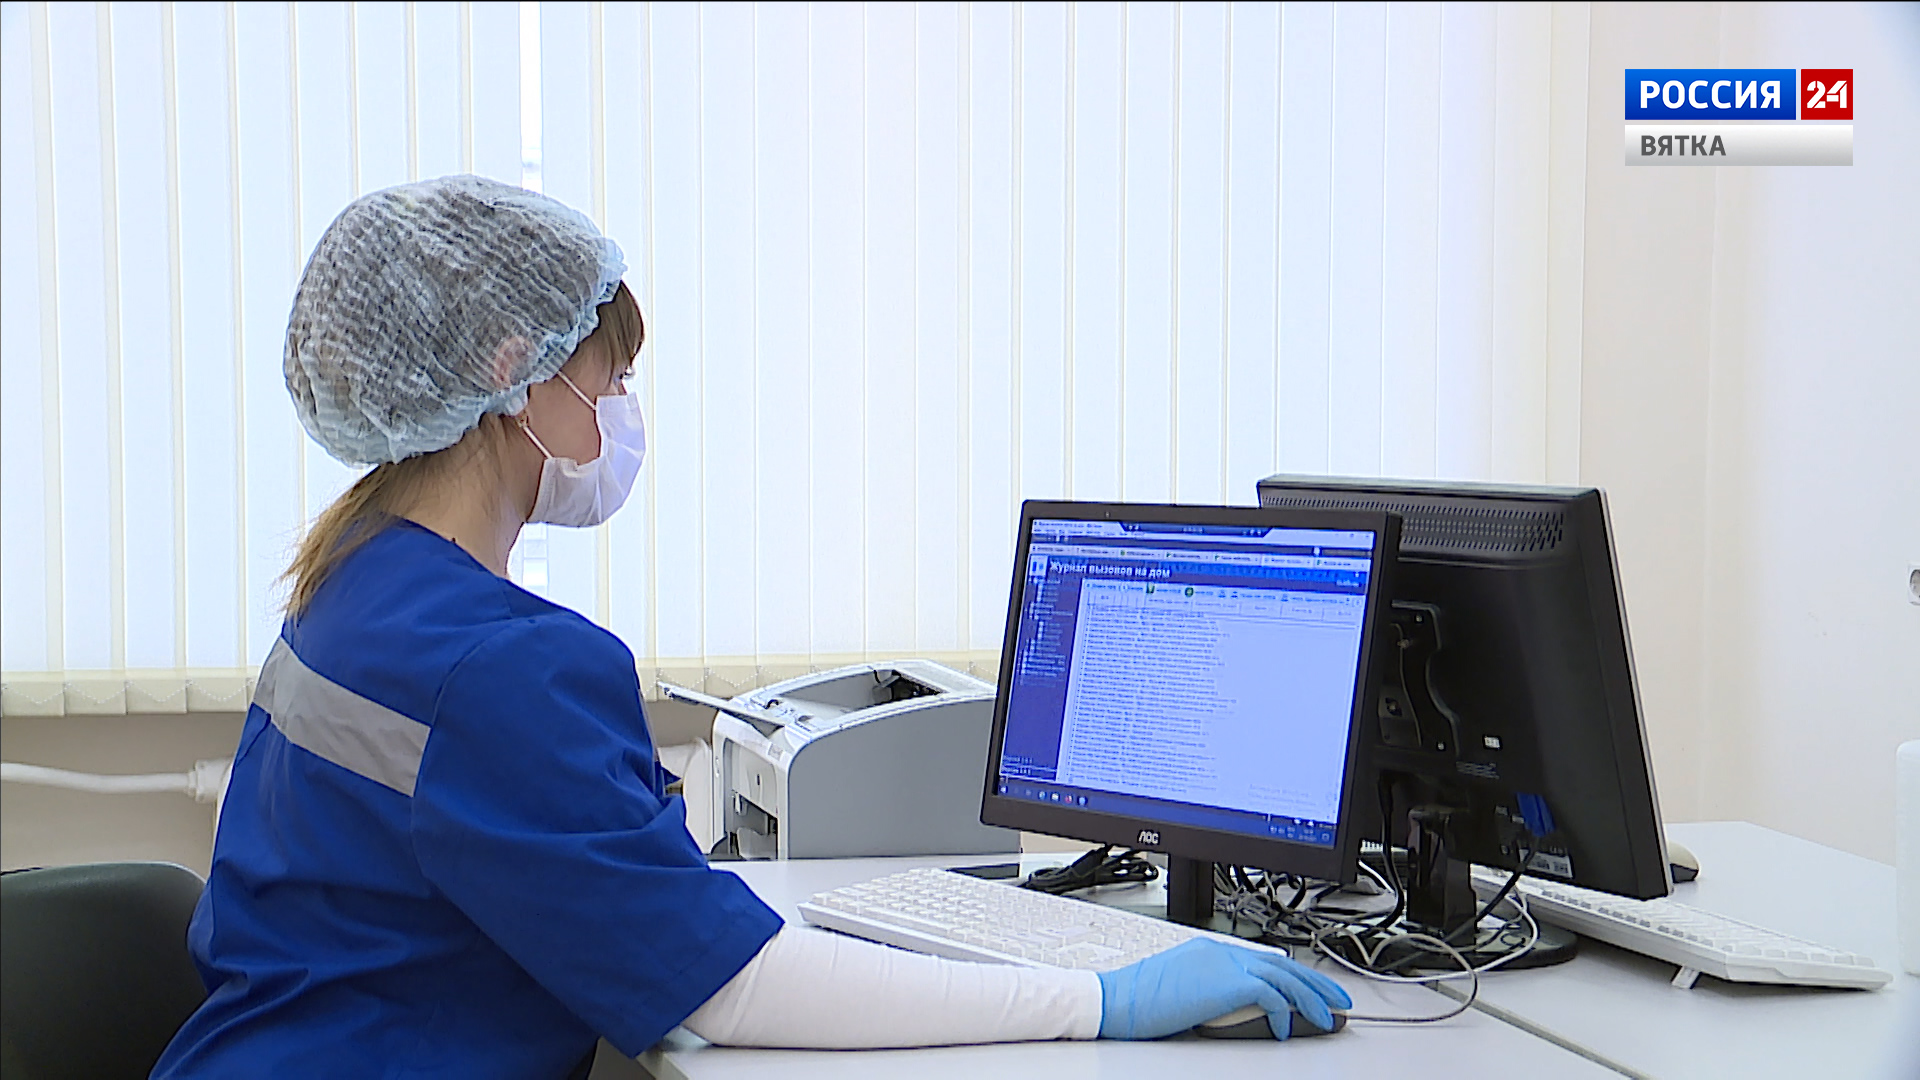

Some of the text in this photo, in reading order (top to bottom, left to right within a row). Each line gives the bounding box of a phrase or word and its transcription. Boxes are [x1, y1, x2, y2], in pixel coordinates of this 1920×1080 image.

[1050, 561, 1171, 579] Журнал вызовов на дом
[1138, 830, 1160, 845] AOC
